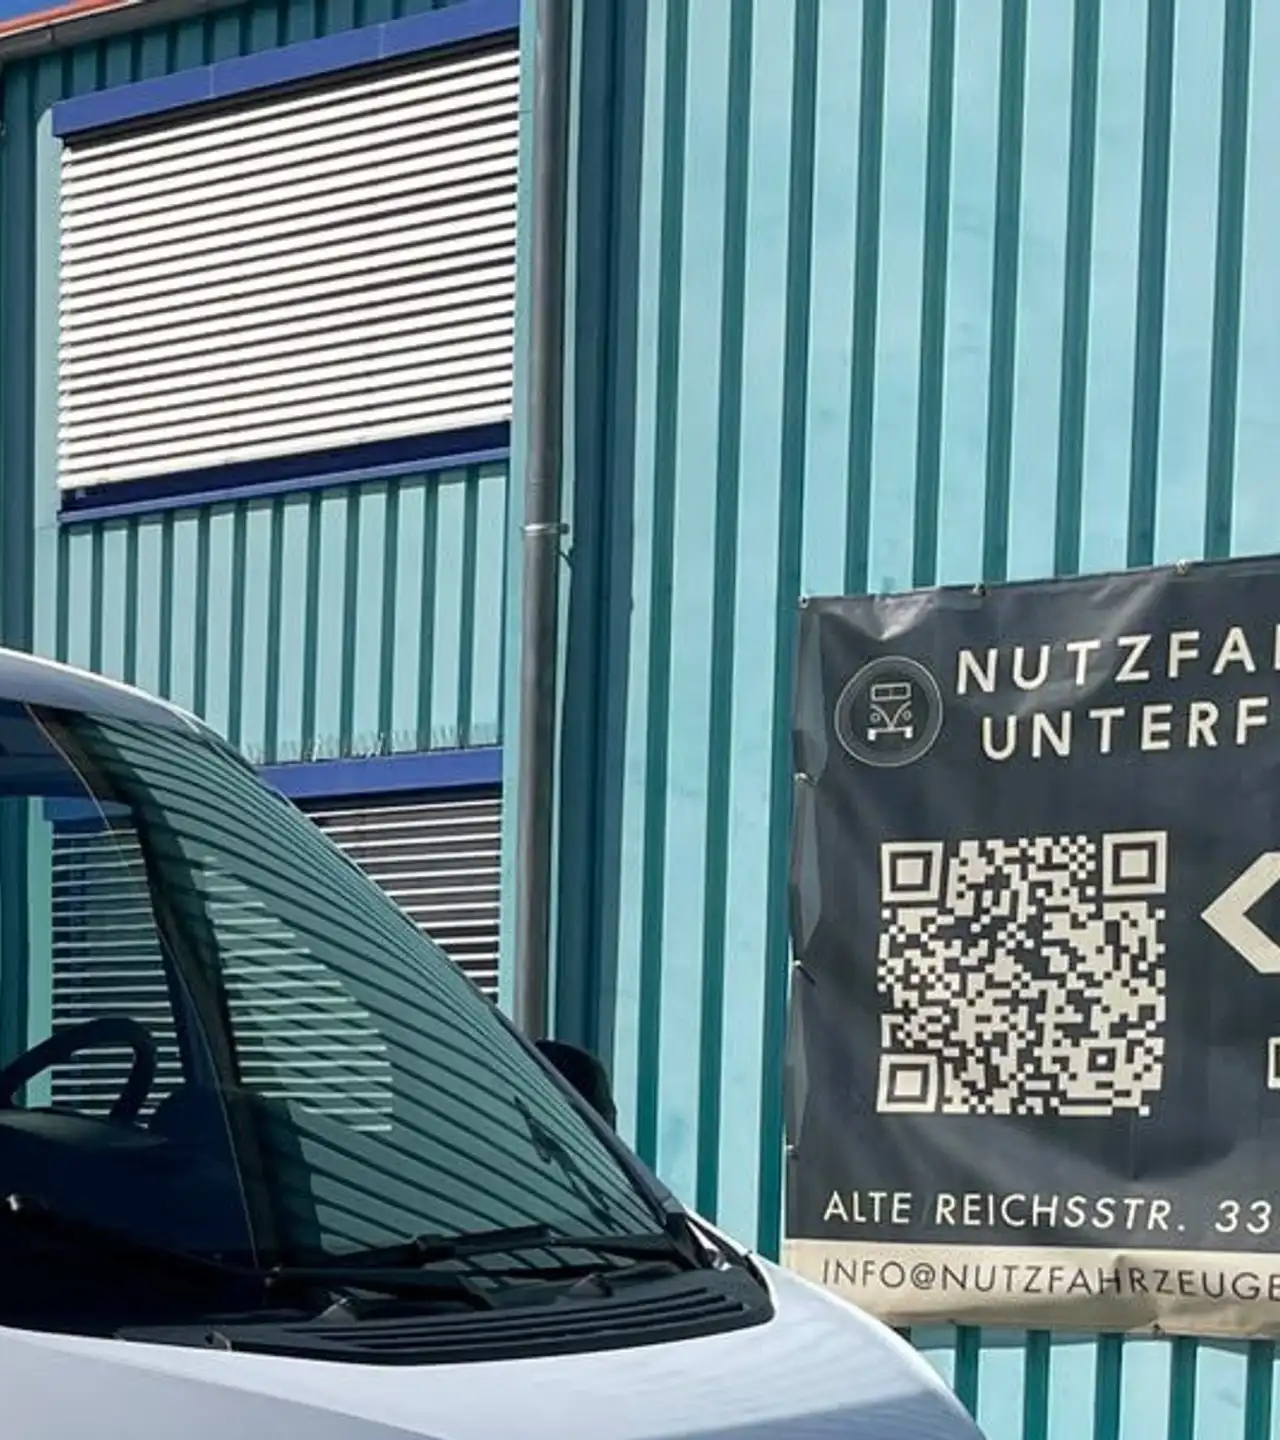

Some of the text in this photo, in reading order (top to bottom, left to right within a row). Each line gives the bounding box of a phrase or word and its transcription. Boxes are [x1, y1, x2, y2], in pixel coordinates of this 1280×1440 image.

[957, 622, 1280, 694] NUTZFA
[982, 697, 1269, 760] UNTERF
[823, 1190, 1271, 1234] ALTE REICHSSTR. 33
